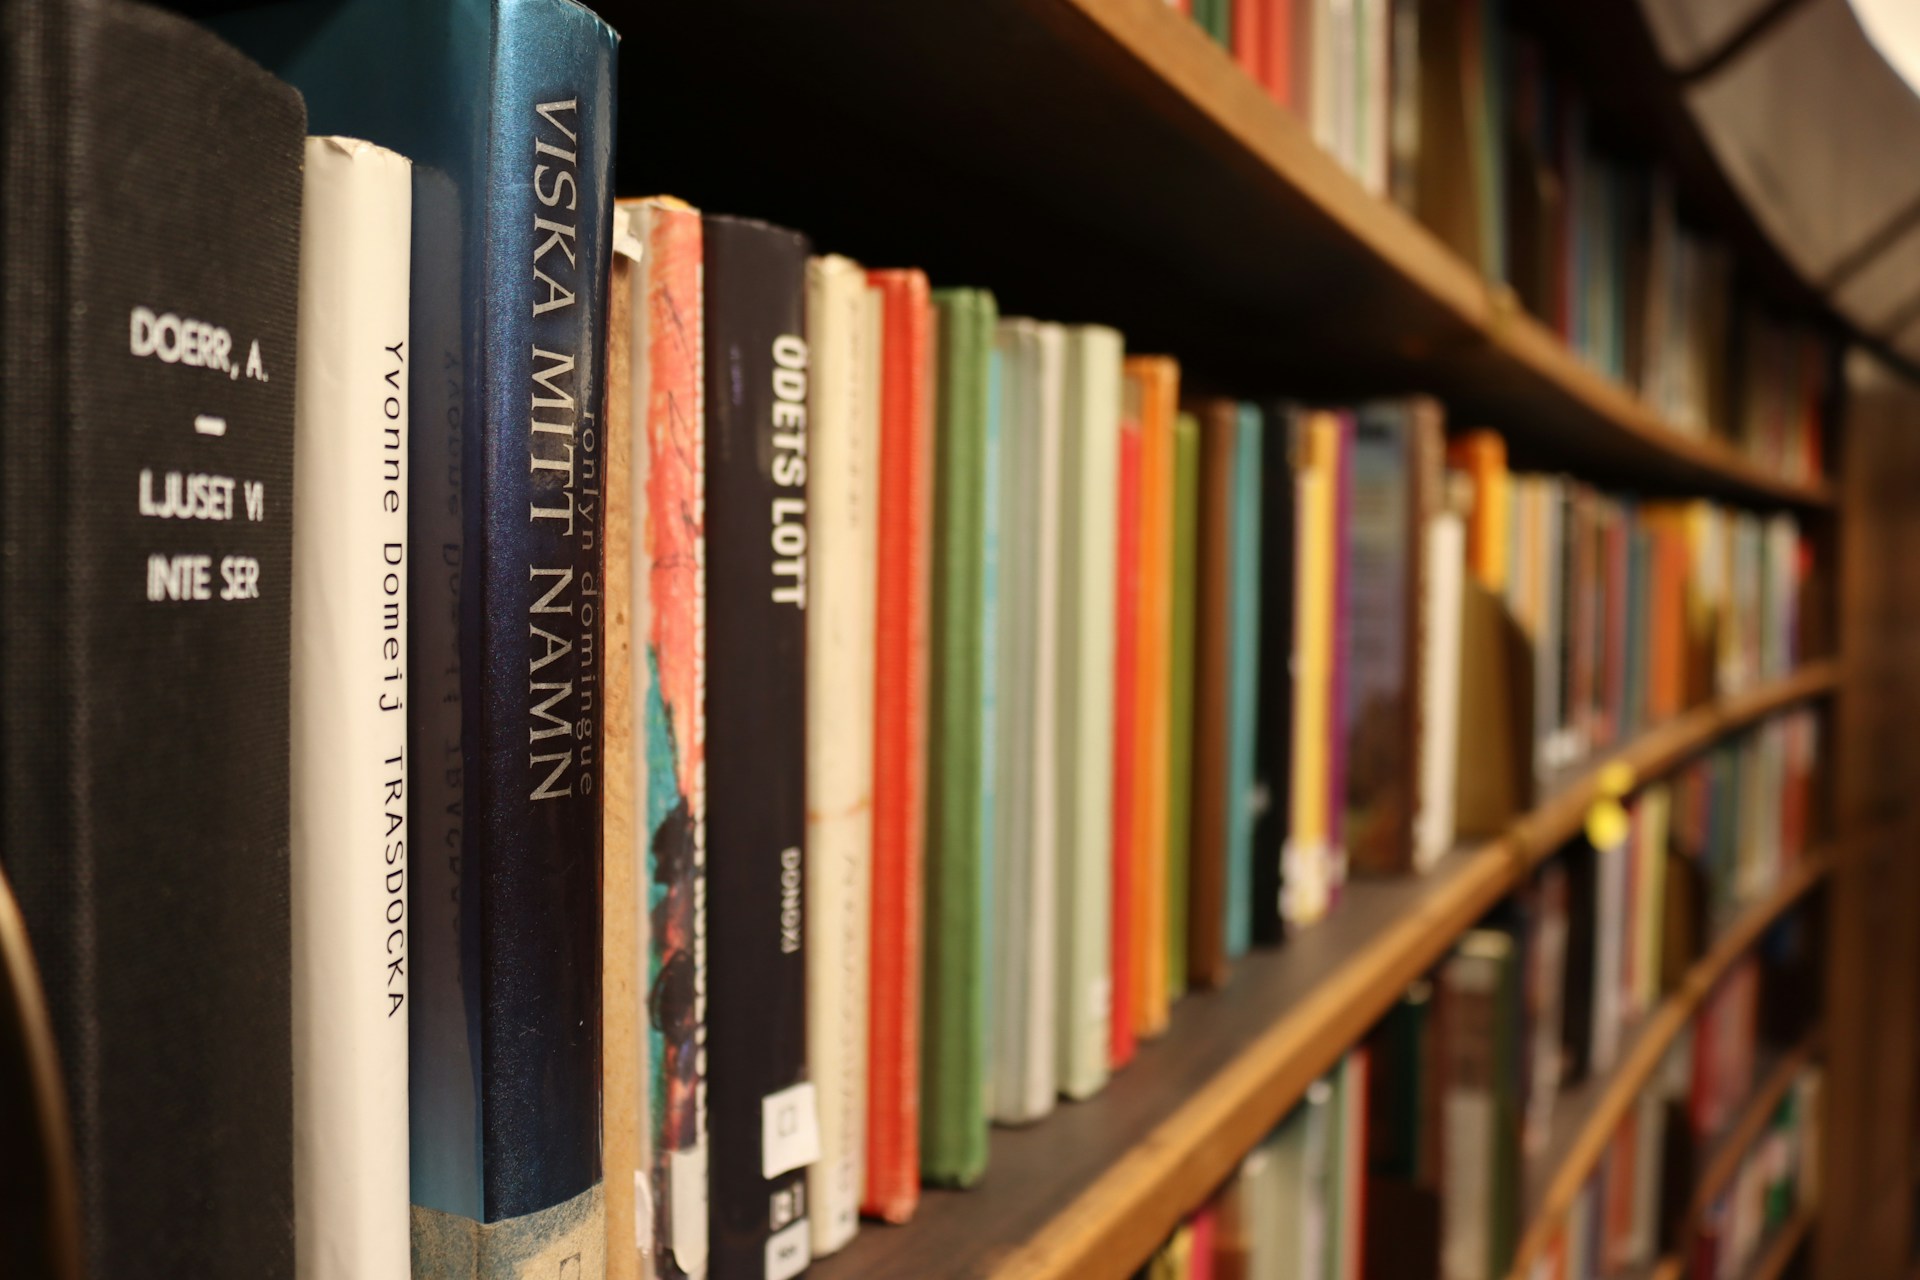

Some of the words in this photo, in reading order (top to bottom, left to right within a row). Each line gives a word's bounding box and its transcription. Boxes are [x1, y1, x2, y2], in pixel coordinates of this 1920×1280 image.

[533, 95, 577, 318] VISKA
[130, 306, 240, 380] DOERR,
[246, 339, 269, 382] A.
[384, 341, 404, 513] Yvonne
[138, 468, 236, 521] LJUSET
[244, 480, 264, 522] VI
[530, 343, 575, 536] MITT
[578, 411, 600, 551] ronlyn
[147, 553, 212, 601] INTE
[220, 555, 260, 601] SER
[379, 543, 403, 712] Domeij
[771, 498, 806, 610] LOTT
[529, 564, 574, 800] NAMN
[576, 571, 597, 796] domingue
[384, 746, 405, 1018] TRASDOCKA
